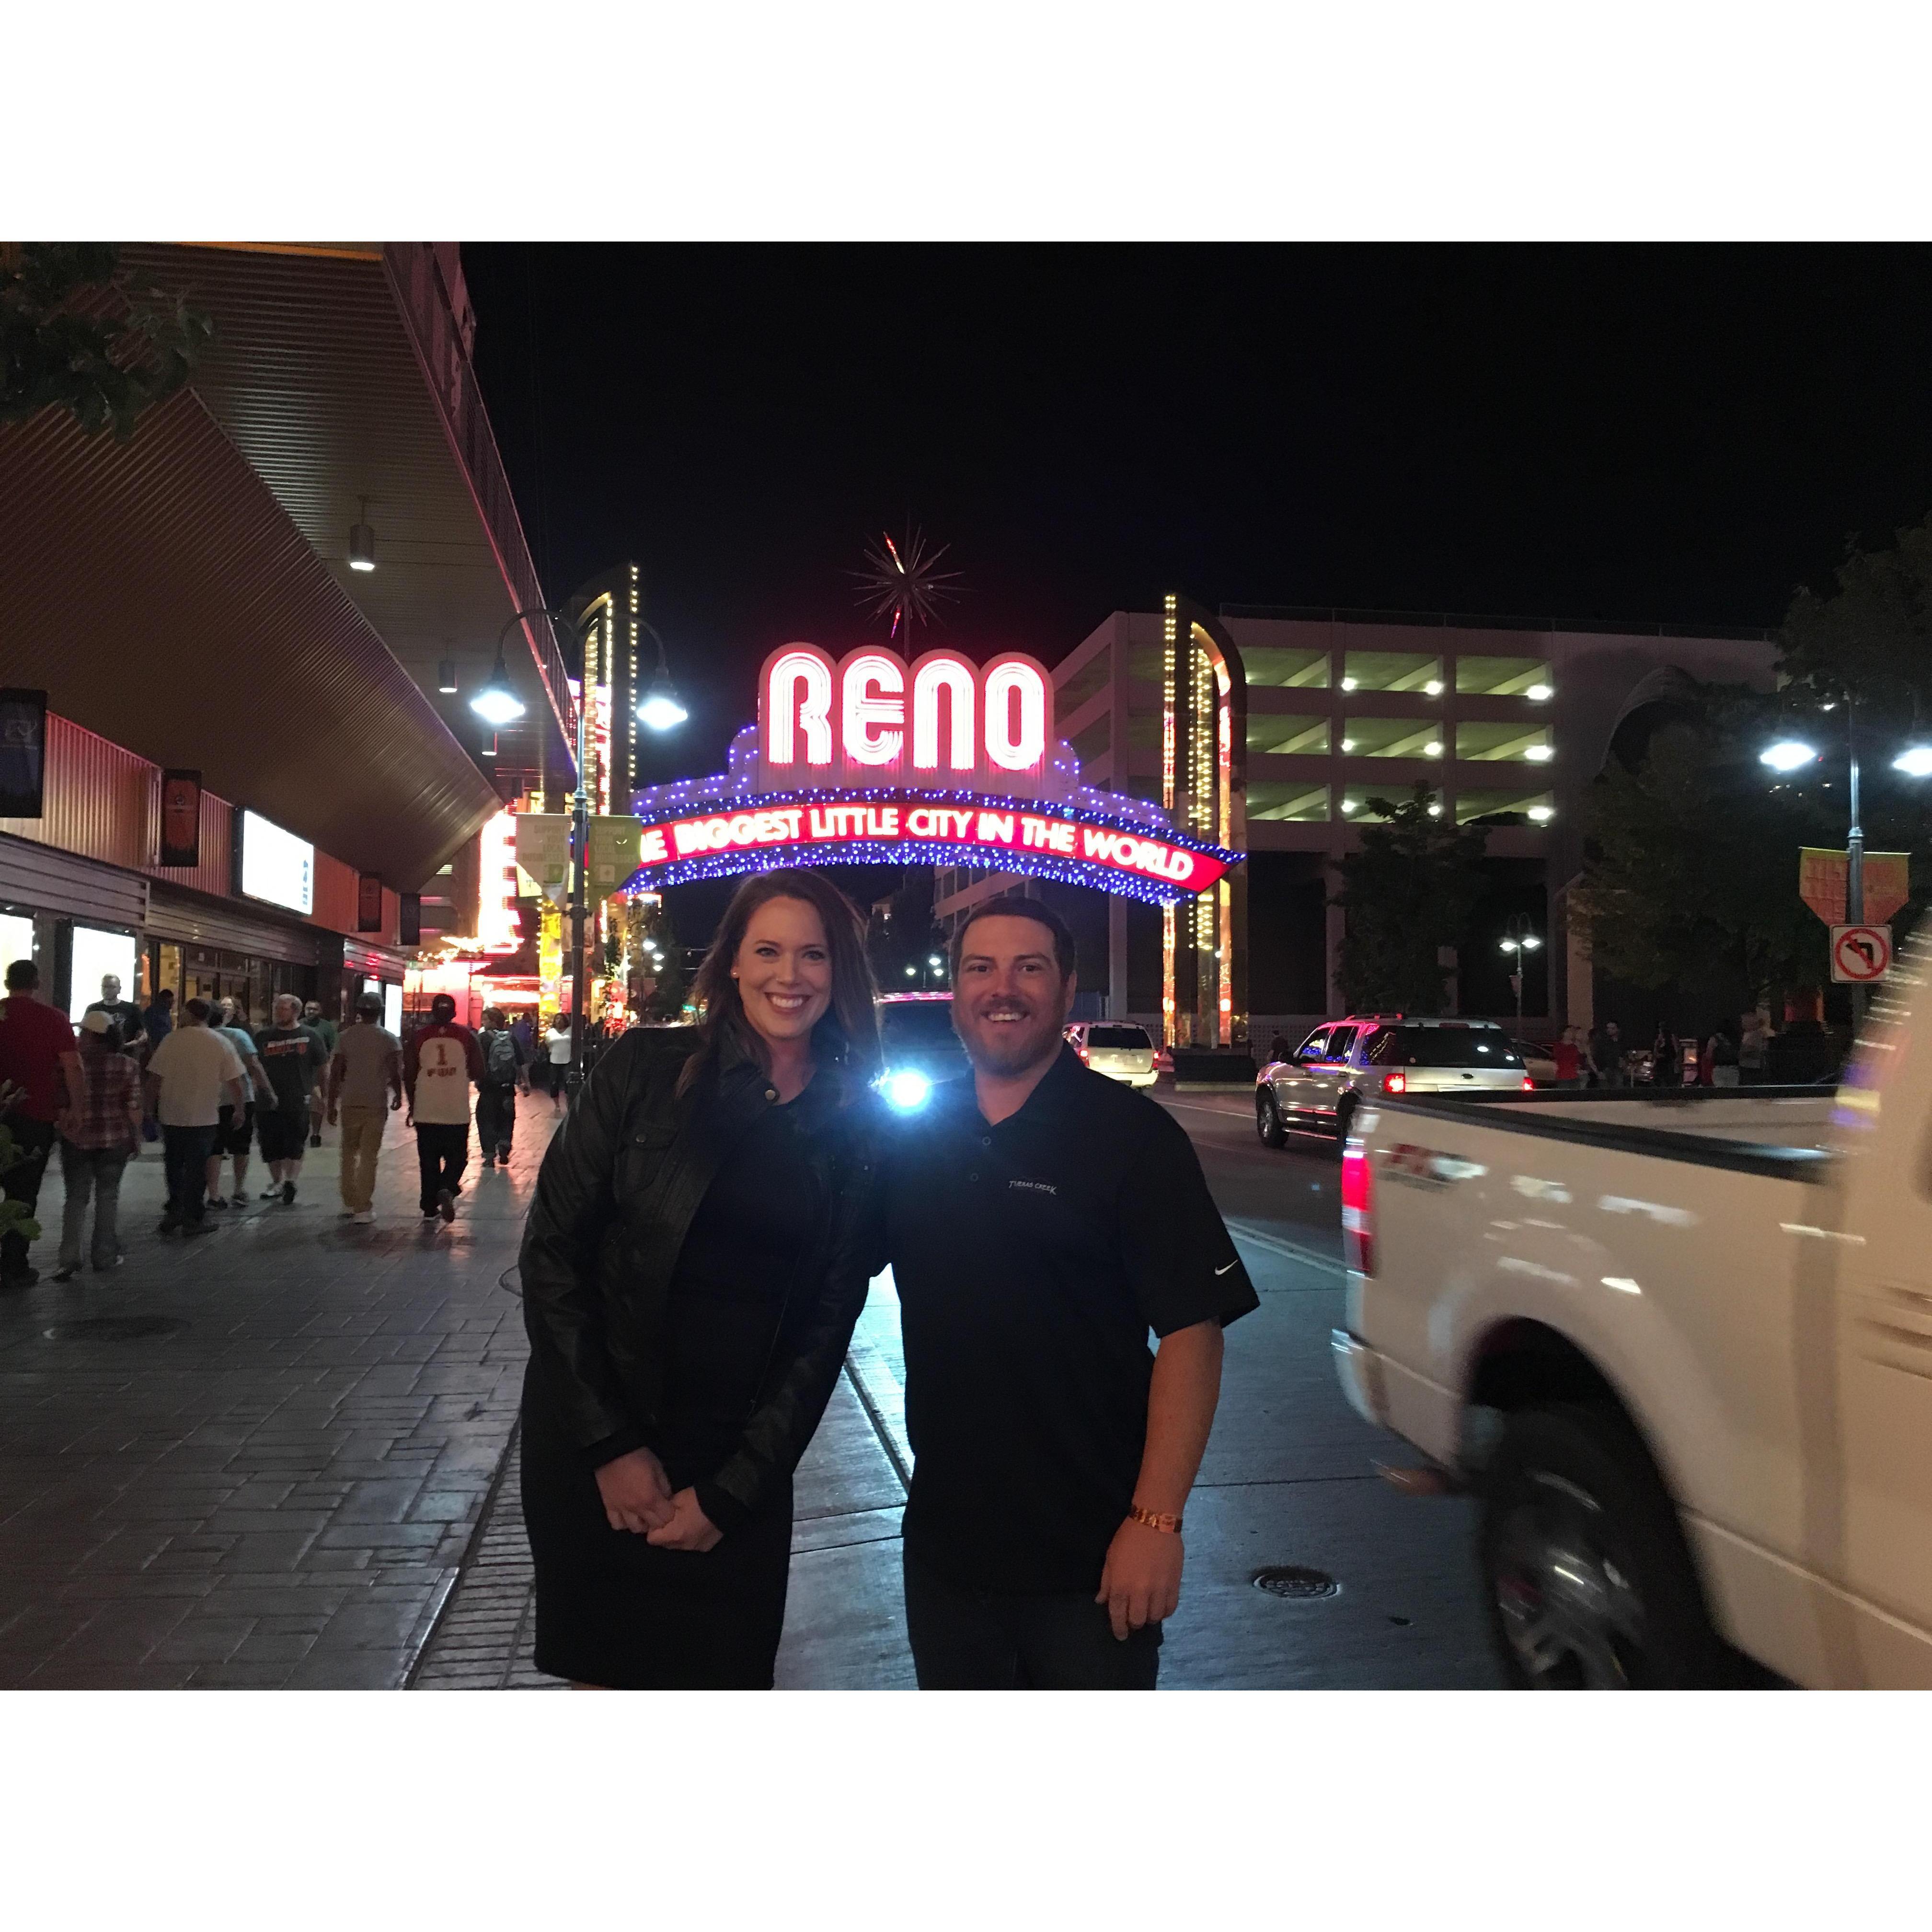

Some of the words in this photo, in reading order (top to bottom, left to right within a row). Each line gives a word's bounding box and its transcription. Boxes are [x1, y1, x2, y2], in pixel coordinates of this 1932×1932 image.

[769, 652, 1045, 770] RENO
[674, 810, 802, 854] BIGGEST
[810, 808, 899, 838] LITTLE
[908, 809, 973, 838] CITY
[978, 813, 1014, 843] IN
[1021, 818, 1075, 852] THE
[1083, 829, 1194, 881] WORLD
[437, 1044, 448, 1065] 1
[1035, 1183, 1057, 1195] CREEK
